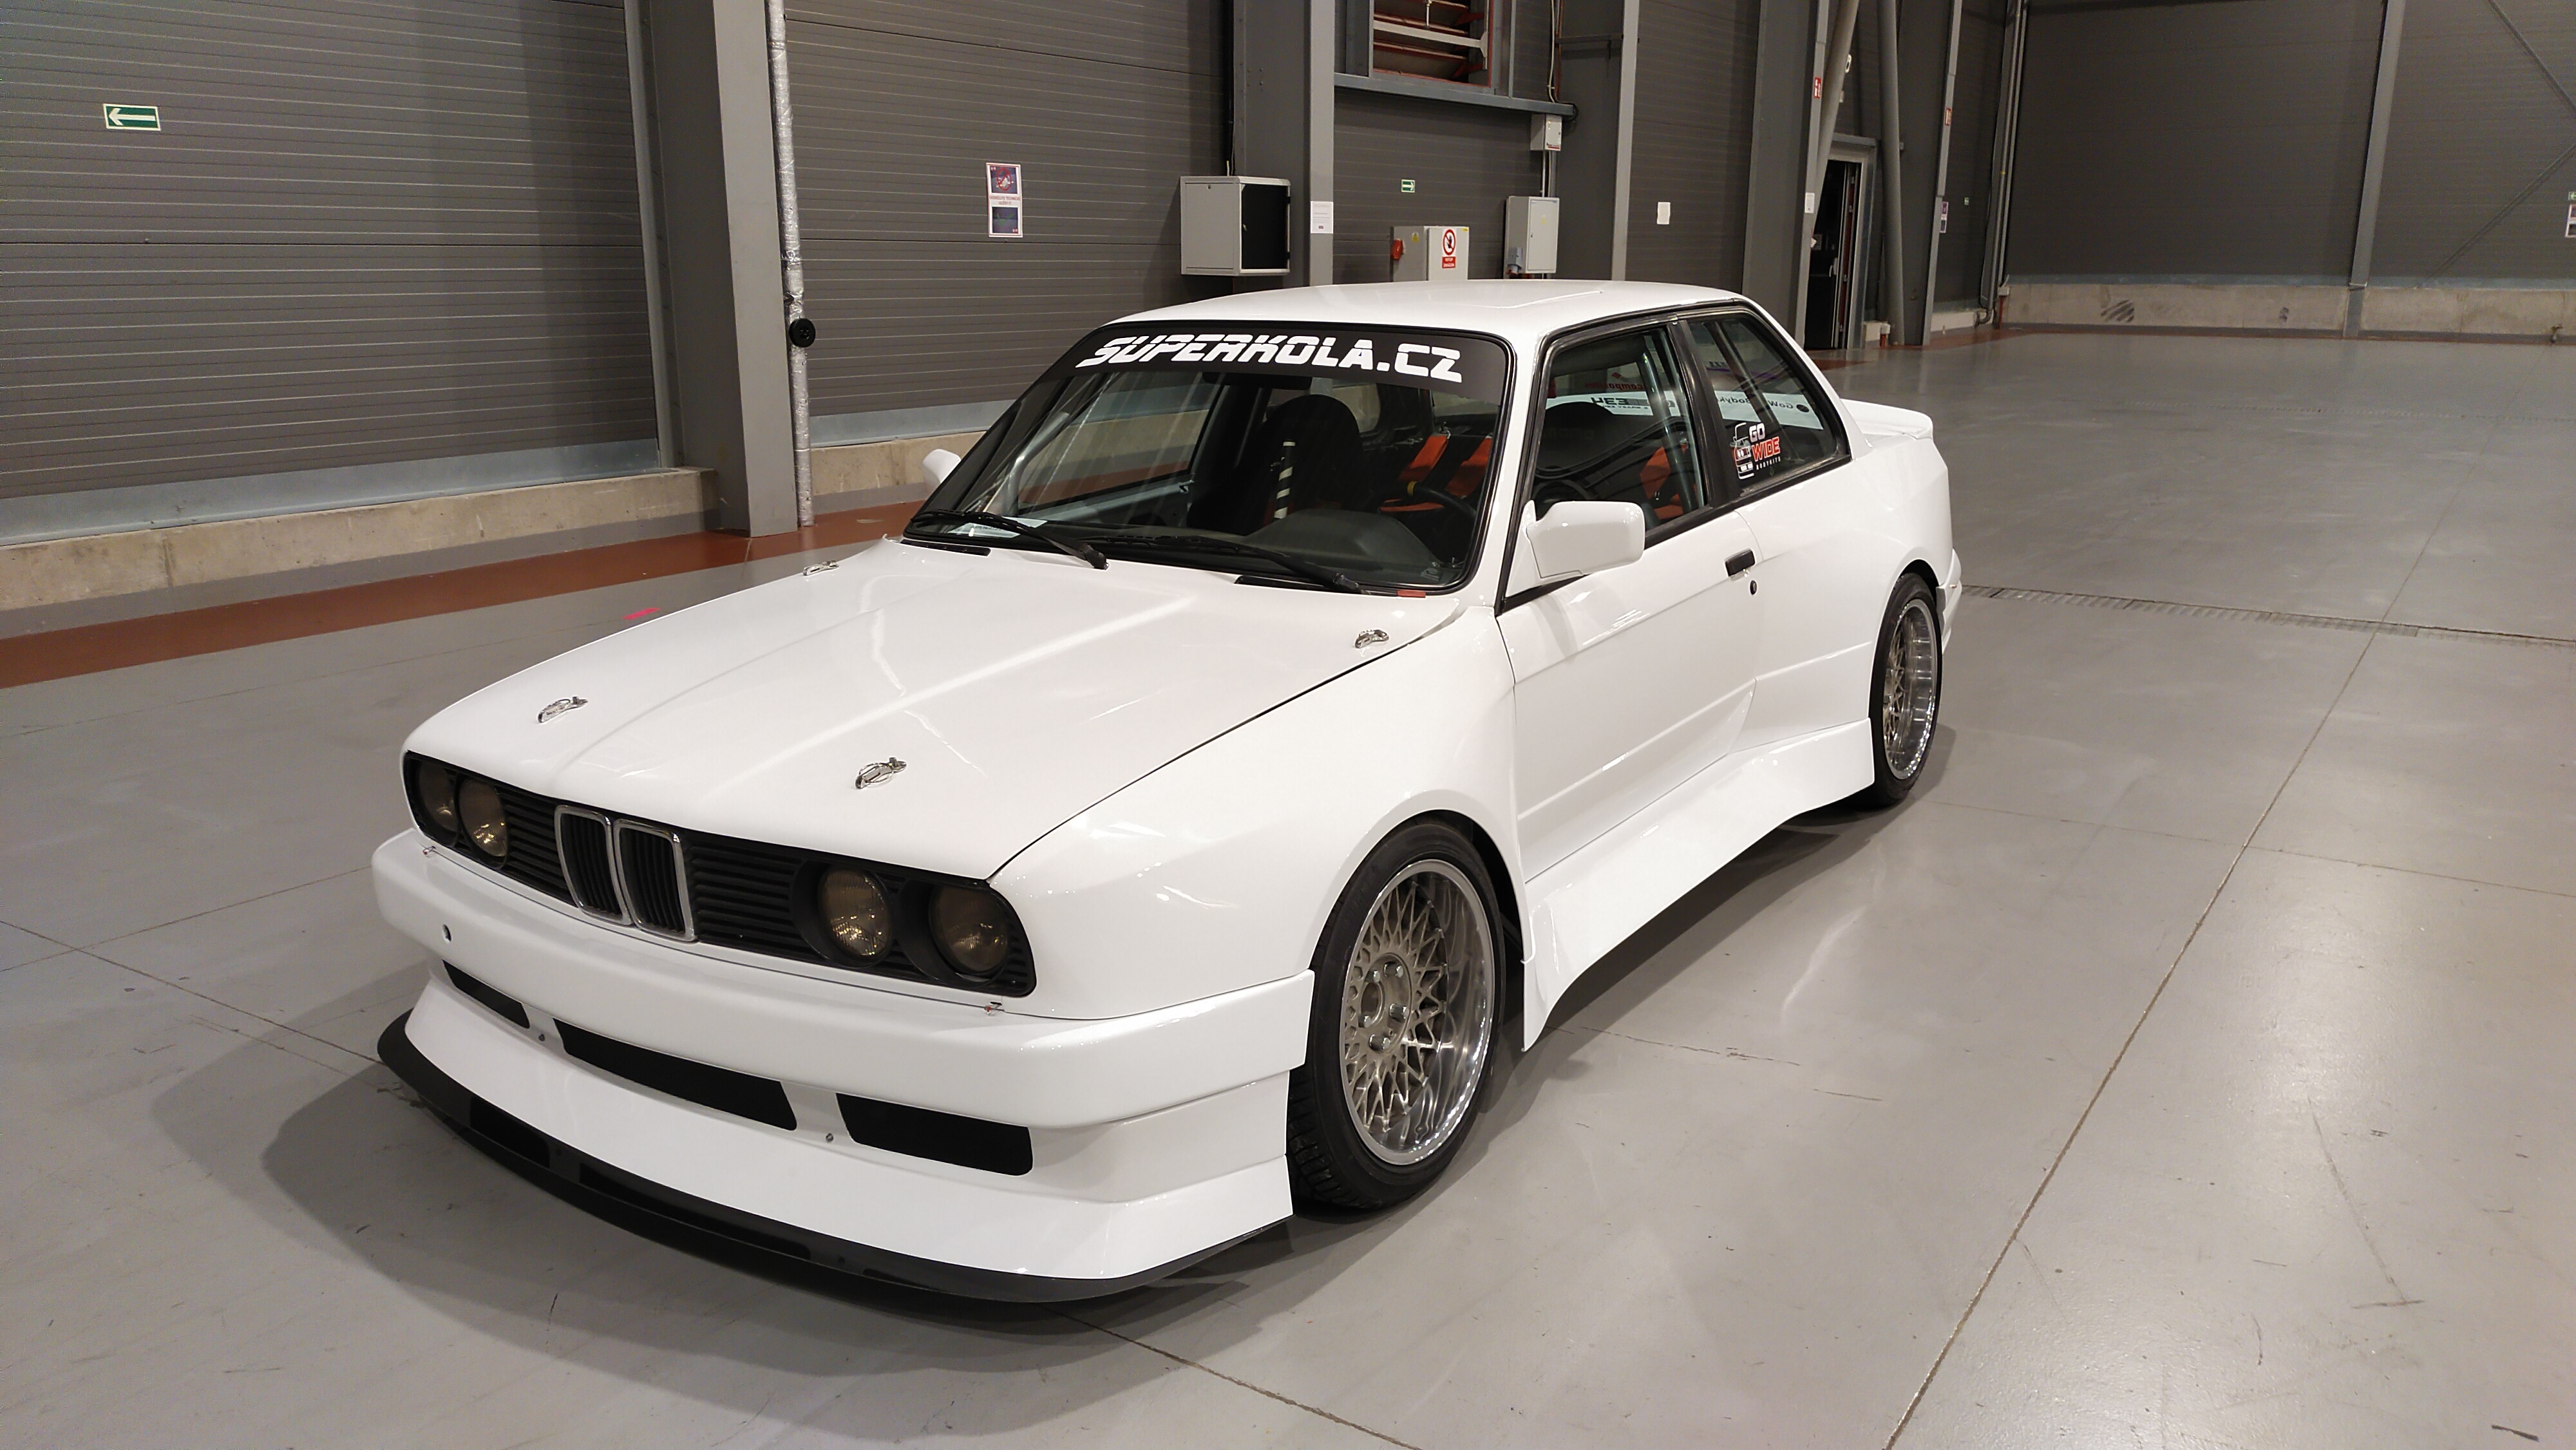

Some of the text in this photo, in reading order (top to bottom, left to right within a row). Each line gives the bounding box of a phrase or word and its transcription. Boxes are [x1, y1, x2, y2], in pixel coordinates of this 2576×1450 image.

[1075, 334, 1463, 383] SUPERKOLA.CZ
[1749, 423, 1765, 443] GO
[1751, 436, 1781, 462] WIDE
